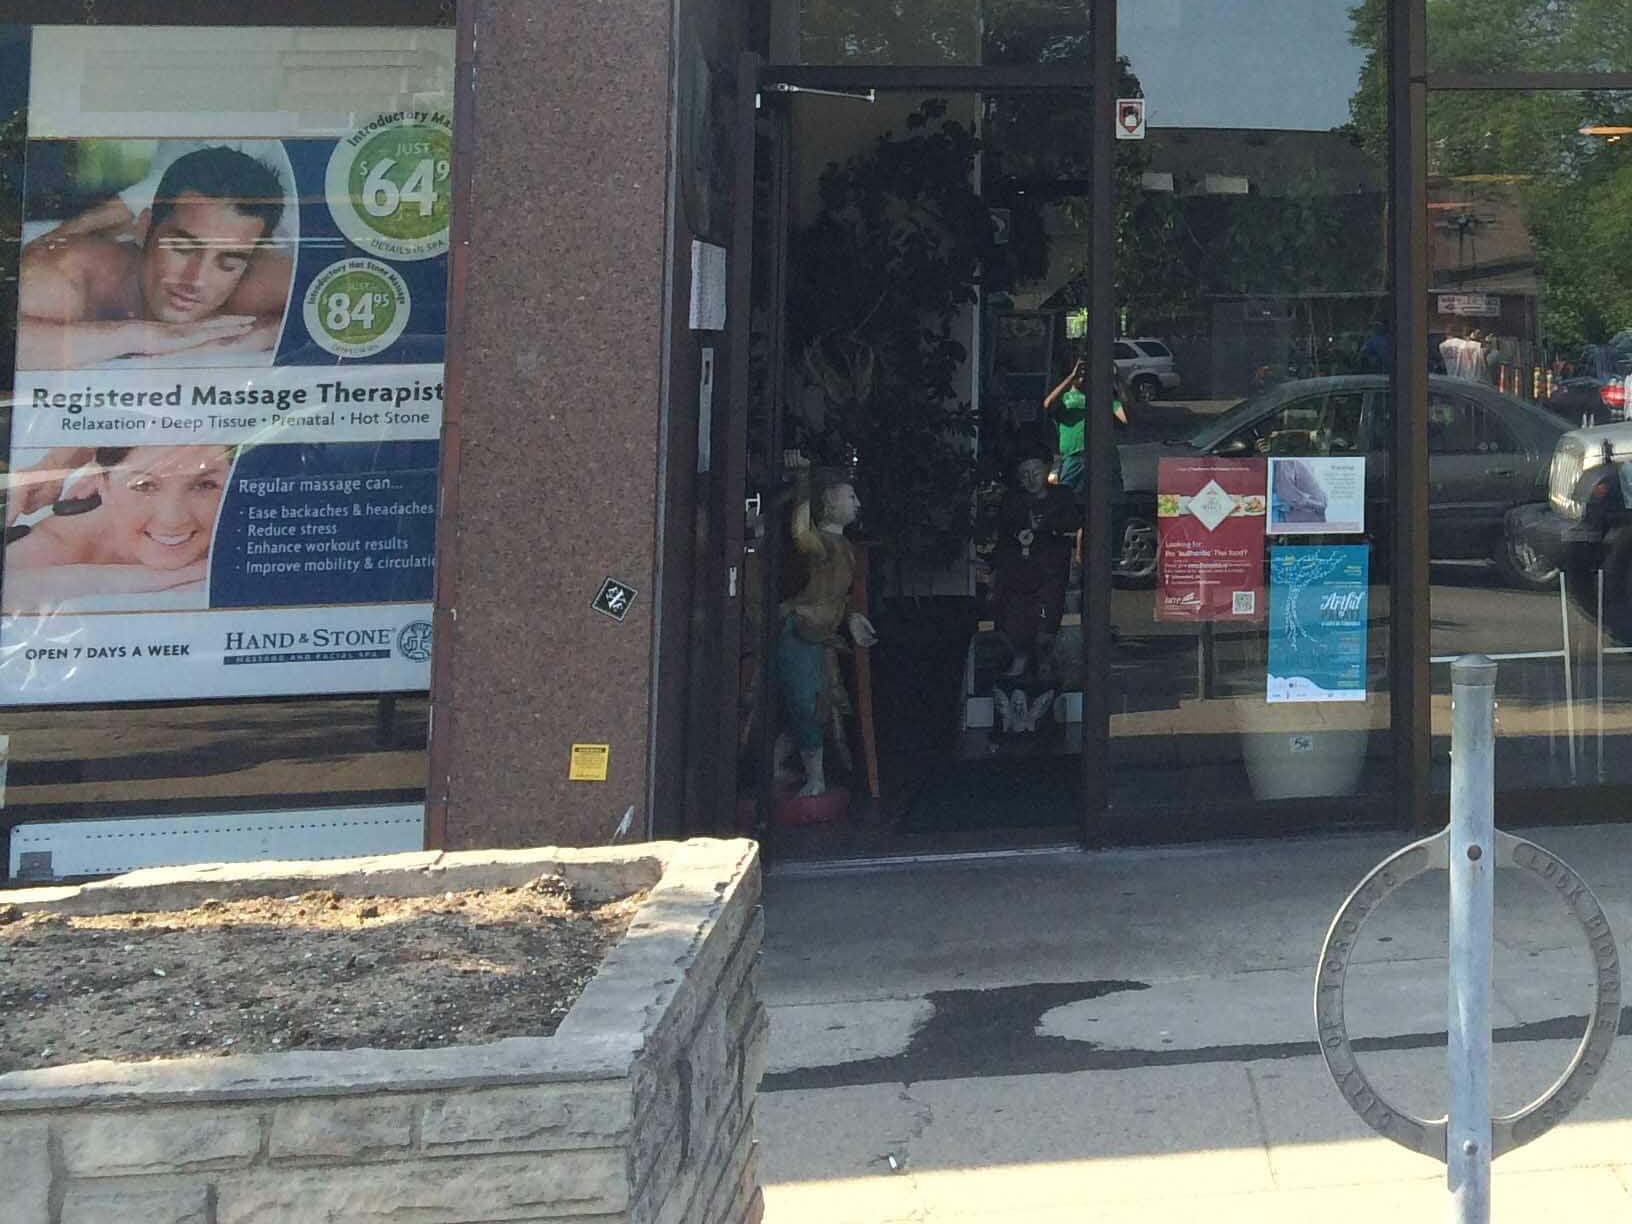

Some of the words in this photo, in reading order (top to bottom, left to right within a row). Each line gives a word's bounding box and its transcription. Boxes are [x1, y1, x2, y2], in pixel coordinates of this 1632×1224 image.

[32, 384, 182, 414] Registered
[191, 385, 307, 411] Massage
[61, 416, 146, 431] Relaxation
[161, 416, 203, 432] Deep
[208, 414, 256, 428] Tissue
[271, 412, 335, 426] Prenatal
[350, 411, 380, 424] Hot
[384, 410, 430, 424] Stone
[239, 478, 295, 496] Regular
[300, 479, 360, 494] massage
[248, 506, 278, 520] Ease
[281, 504, 348, 519] backaches
[352, 503, 361, 517] &
[366, 501, 434, 516] headaches
[247, 524, 296, 537] Reduce
[300, 524, 337, 536] stress
[246, 541, 302, 555] Enhance
[305, 539, 360, 553] workout
[364, 536, 408, 551] results
[245, 560, 300, 576] Improve
[304, 556, 360, 572] mobility
[364, 556, 374, 570] &
[224, 631, 294, 651] HAND
[299, 633, 309, 644] &
[312, 627, 392, 648] STONE
[25, 648, 68, 660] OPEN
[73, 648, 82, 659] 7
[87, 646, 126, 658] DAYS
[131, 646, 142, 657] A
[147, 644, 190, 656] WEEK
